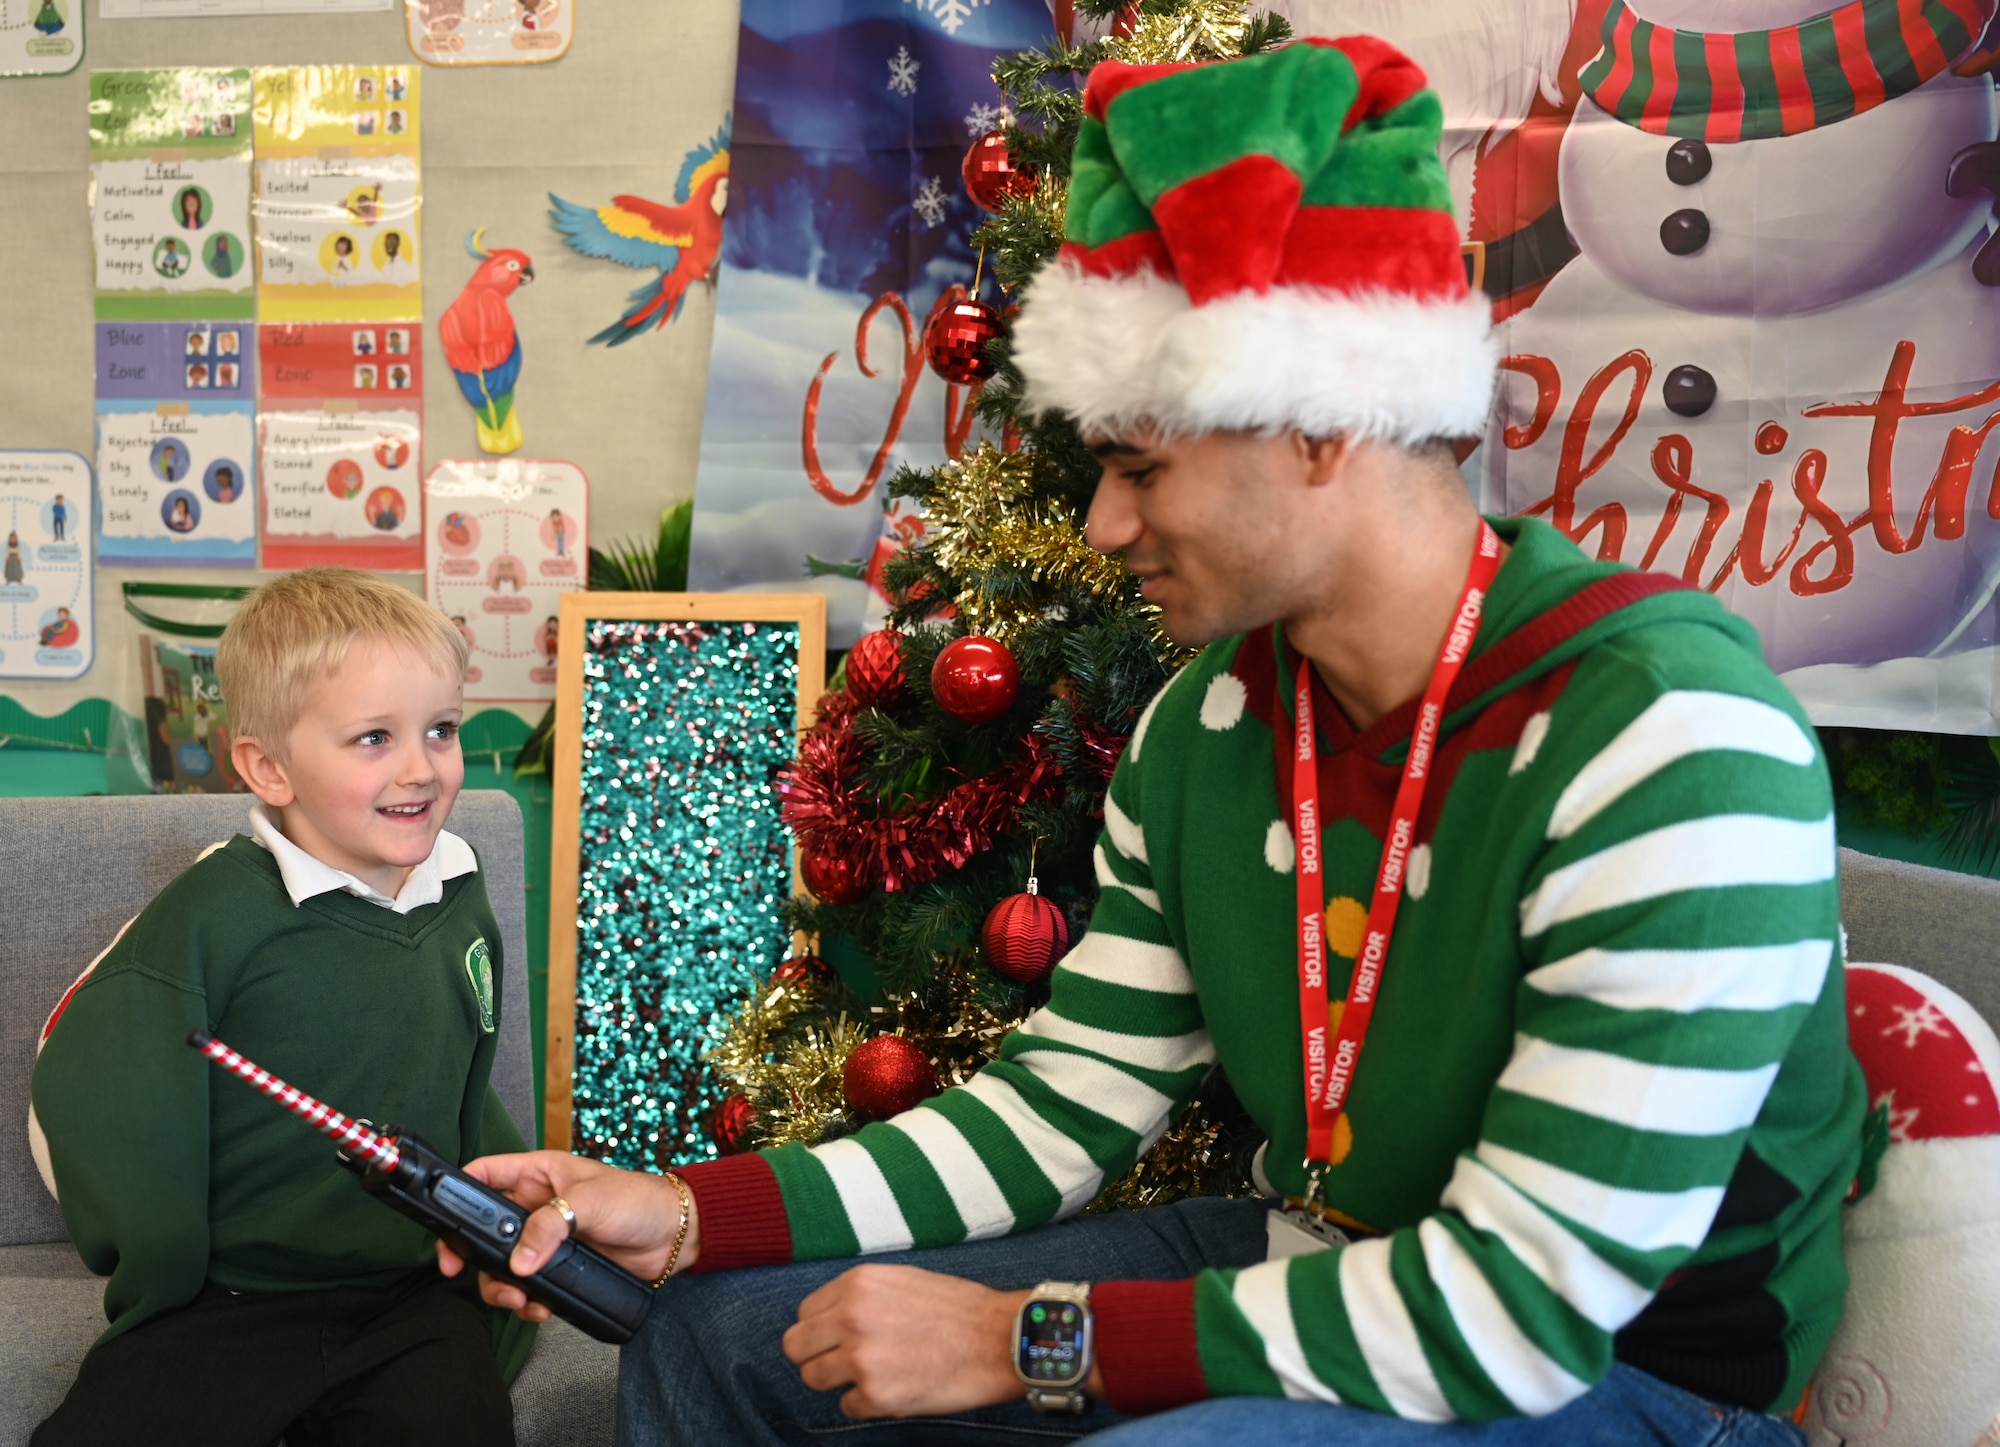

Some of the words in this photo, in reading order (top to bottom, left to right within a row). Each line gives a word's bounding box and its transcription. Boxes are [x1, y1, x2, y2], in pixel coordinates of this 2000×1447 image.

[104, 185, 163, 197] Motivated
[268, 181, 309, 194] Excited
[104, 210, 134, 221] Calm
[105, 234, 154, 249] Engaged
[105, 259, 143, 274] Happy
[269, 257, 294, 273] Silly
[107, 329, 145, 347] Blue
[271, 330, 304, 348] Red
[108, 364, 147, 380] Zone
[274, 364, 312, 382] Zone
[108, 436, 157, 452] Rejected
[110, 461, 131, 476] Shy
[274, 459, 312, 470] Scared
[110, 486, 148, 501] Lonely
[274, 482, 325, 494] Terrified
[109, 510, 132, 522] Sick
[274, 507, 312, 519] Elated
[1442, 588, 1484, 664] VISITOR
[1298, 687, 1312, 761] VISITOR
[1409, 702, 1439, 779] VISITOR
[1299, 799, 1318, 874] VISITOR
[1379, 818, 1412, 893] VISITOR
[1302, 912, 1322, 988] VISITOR
[1353, 931, 1386, 1004] VISITOR
[1323, 1040, 1357, 1110] VISITOR
